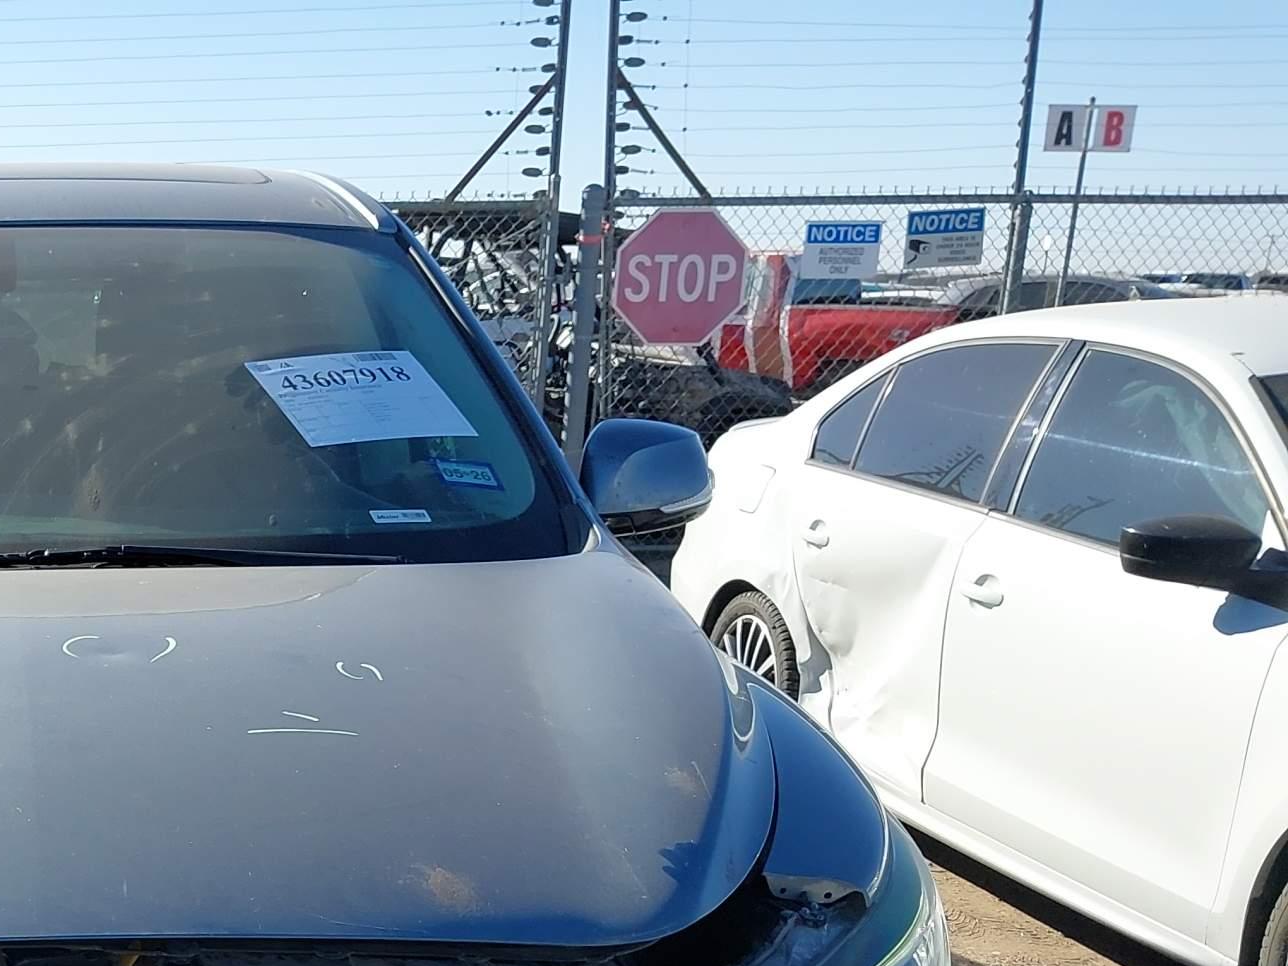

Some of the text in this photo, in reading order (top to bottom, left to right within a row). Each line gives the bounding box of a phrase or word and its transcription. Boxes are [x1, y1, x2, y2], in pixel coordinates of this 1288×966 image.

[1054, 111, 1074, 146] A
[1103, 111, 1125, 146] B
[911, 212, 981, 232] NOTICE
[810, 226, 878, 242] NOTICE
[818, 247, 865, 256] AUTHORIZED
[818, 256, 862, 265] PERSONNEL
[624, 253, 737, 303] STOP
[829, 265, 849, 274] ONLY
[280, 365, 413, 391] 43607918
